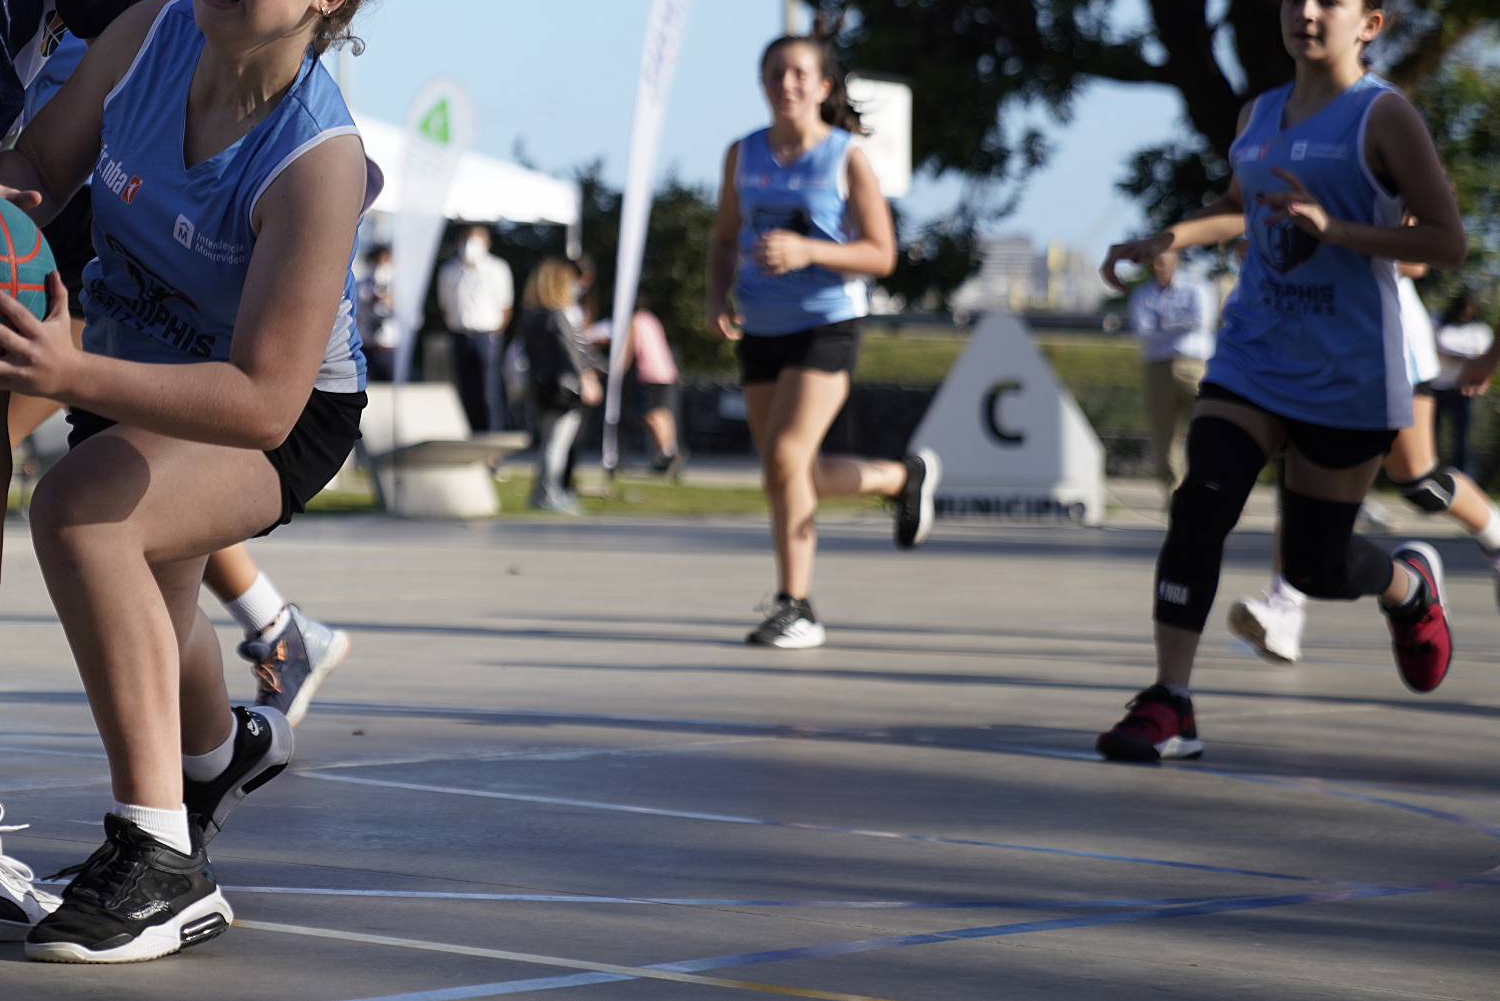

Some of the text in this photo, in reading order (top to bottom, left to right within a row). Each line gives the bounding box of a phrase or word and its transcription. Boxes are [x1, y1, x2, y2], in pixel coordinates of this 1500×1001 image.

[100, 159, 128, 196] nba
[194, 242, 246, 265] Montevideo
[196, 232, 244, 254] Intendencia
[981, 380, 1026, 449] C
